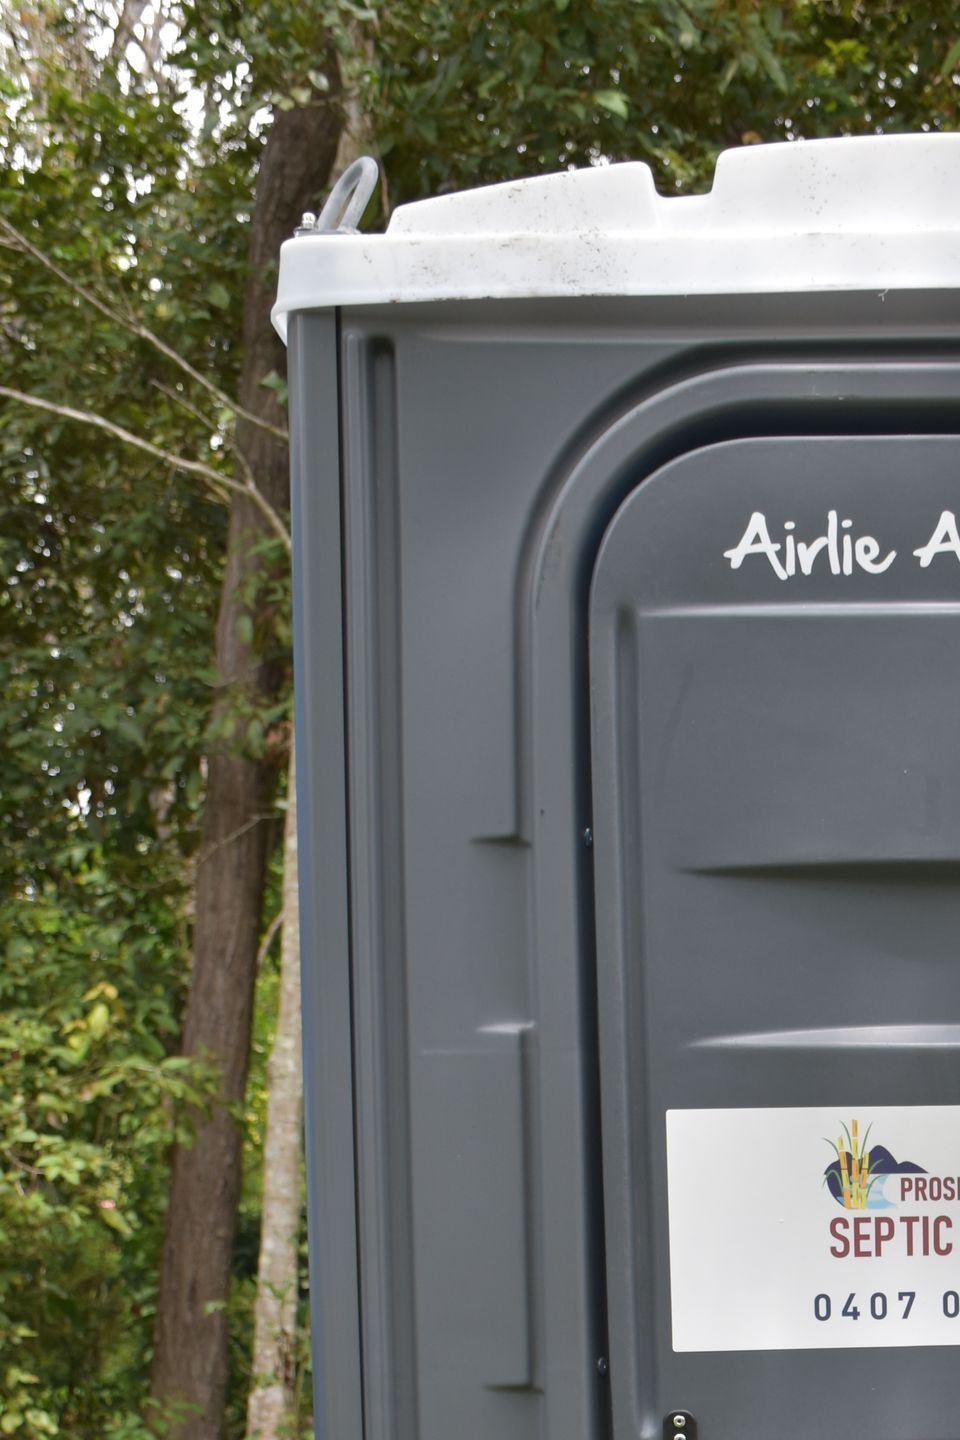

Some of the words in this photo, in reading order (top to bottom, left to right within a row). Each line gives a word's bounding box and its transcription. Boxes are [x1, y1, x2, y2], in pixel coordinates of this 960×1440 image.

[723, 509, 897, 581] Airlie
[829, 1215, 953, 1259] SEPTIC
[814, 1291, 916, 1322] 0407
